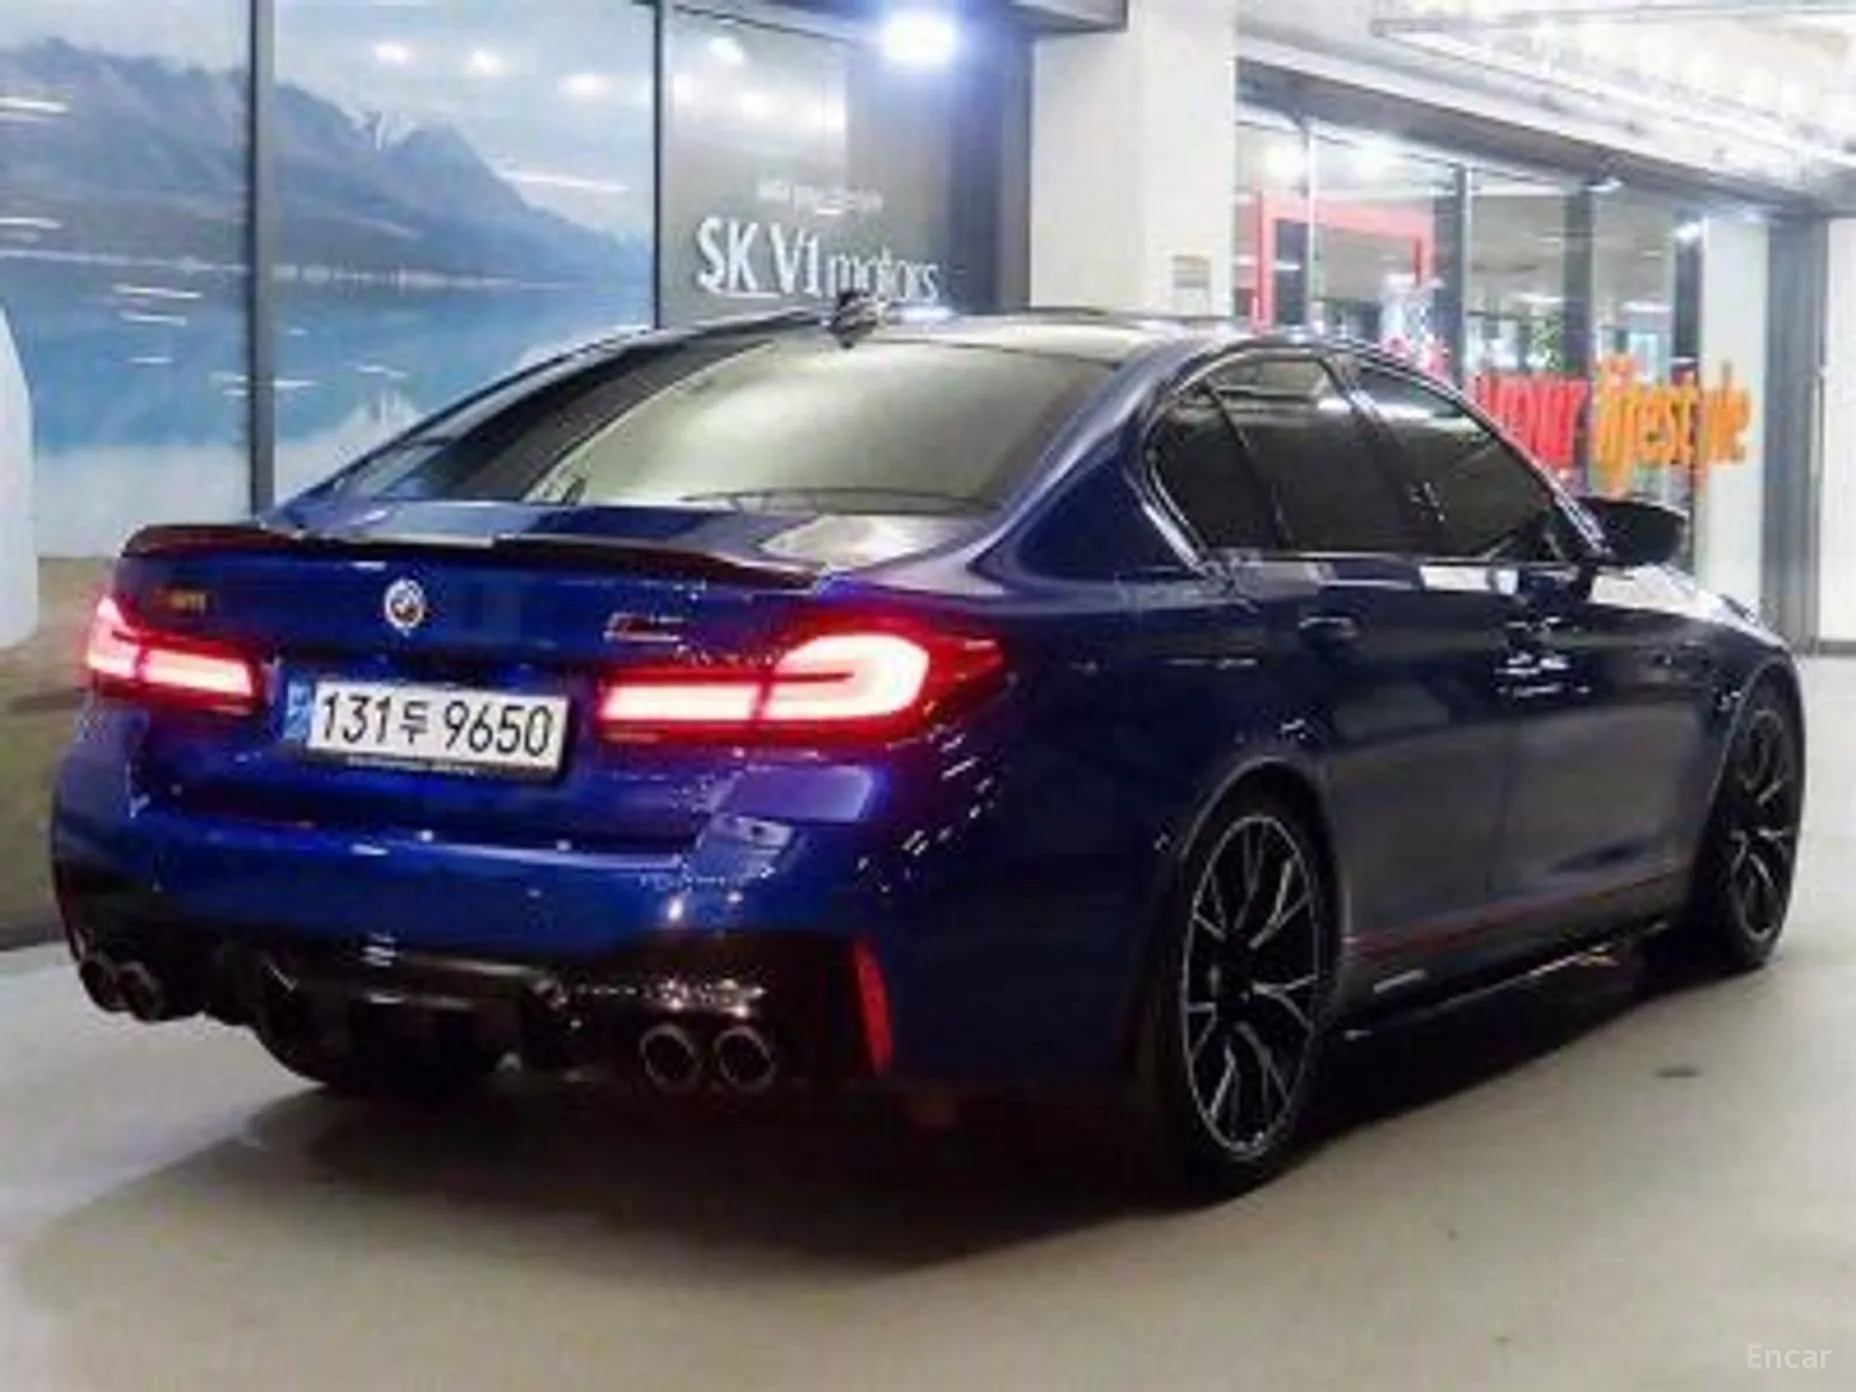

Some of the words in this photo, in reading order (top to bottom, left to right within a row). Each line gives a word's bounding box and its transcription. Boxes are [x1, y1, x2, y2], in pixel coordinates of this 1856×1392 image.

[697, 216, 759, 296] SK
[321, 692, 428, 744] 131두
[443, 700, 552, 757] 9650
